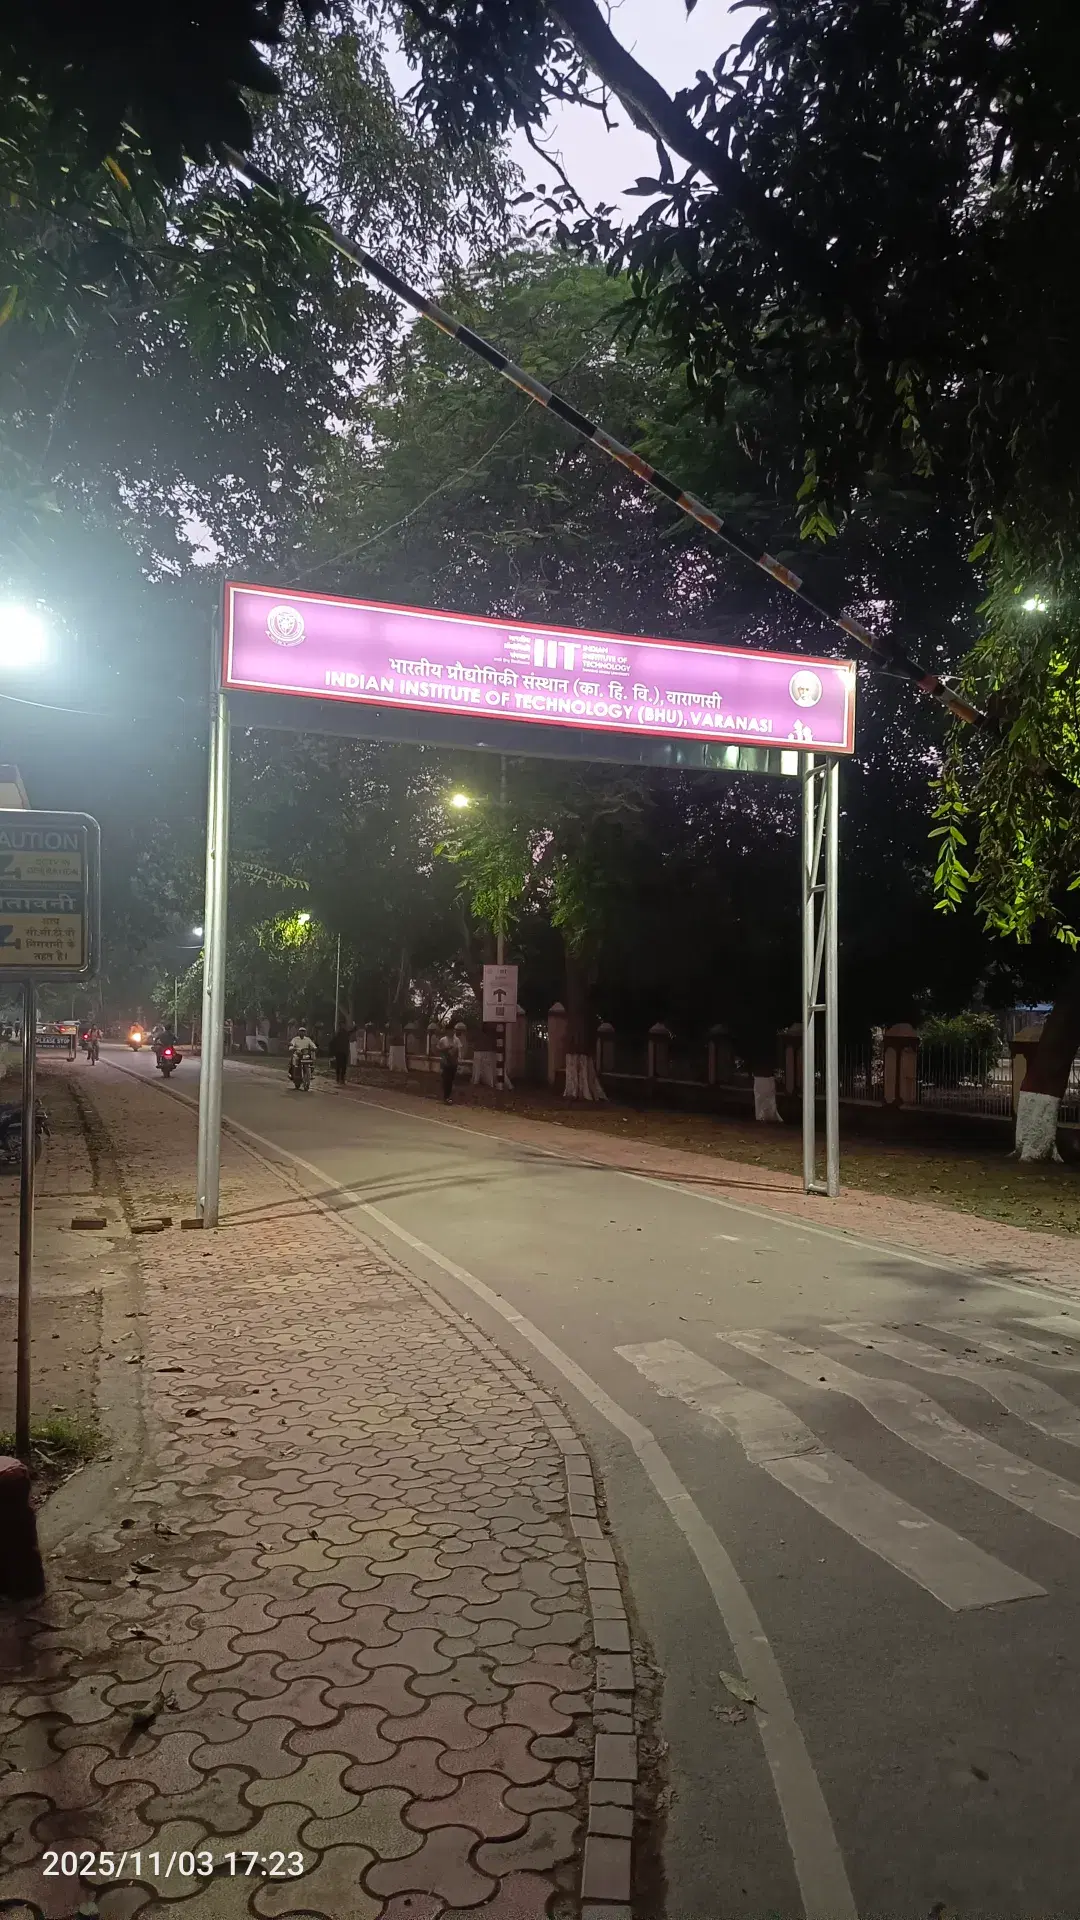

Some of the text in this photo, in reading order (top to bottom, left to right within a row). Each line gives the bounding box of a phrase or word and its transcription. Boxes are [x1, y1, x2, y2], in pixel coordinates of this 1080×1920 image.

[534, 638, 581, 671] IIT
[617, 656, 628, 664] OF
[582, 660, 631, 672] TECHNOLOGY
[389, 657, 443, 679] भारतीय
[446, 660, 519, 688] प्रौद्योगिकी
[521, 672, 570, 694] संस्थान
[573, 677, 604, 698] (का.
[608, 680, 628, 700] हि.
[666, 690, 723, 710] वाराणसी
[325, 671, 773, 733] INDIAN INSTITUTE OF TECHNOLOGY (BHU), VARANASI
[0, 831, 78, 850] AUTION
[0, 893, 77, 911] तावनी
